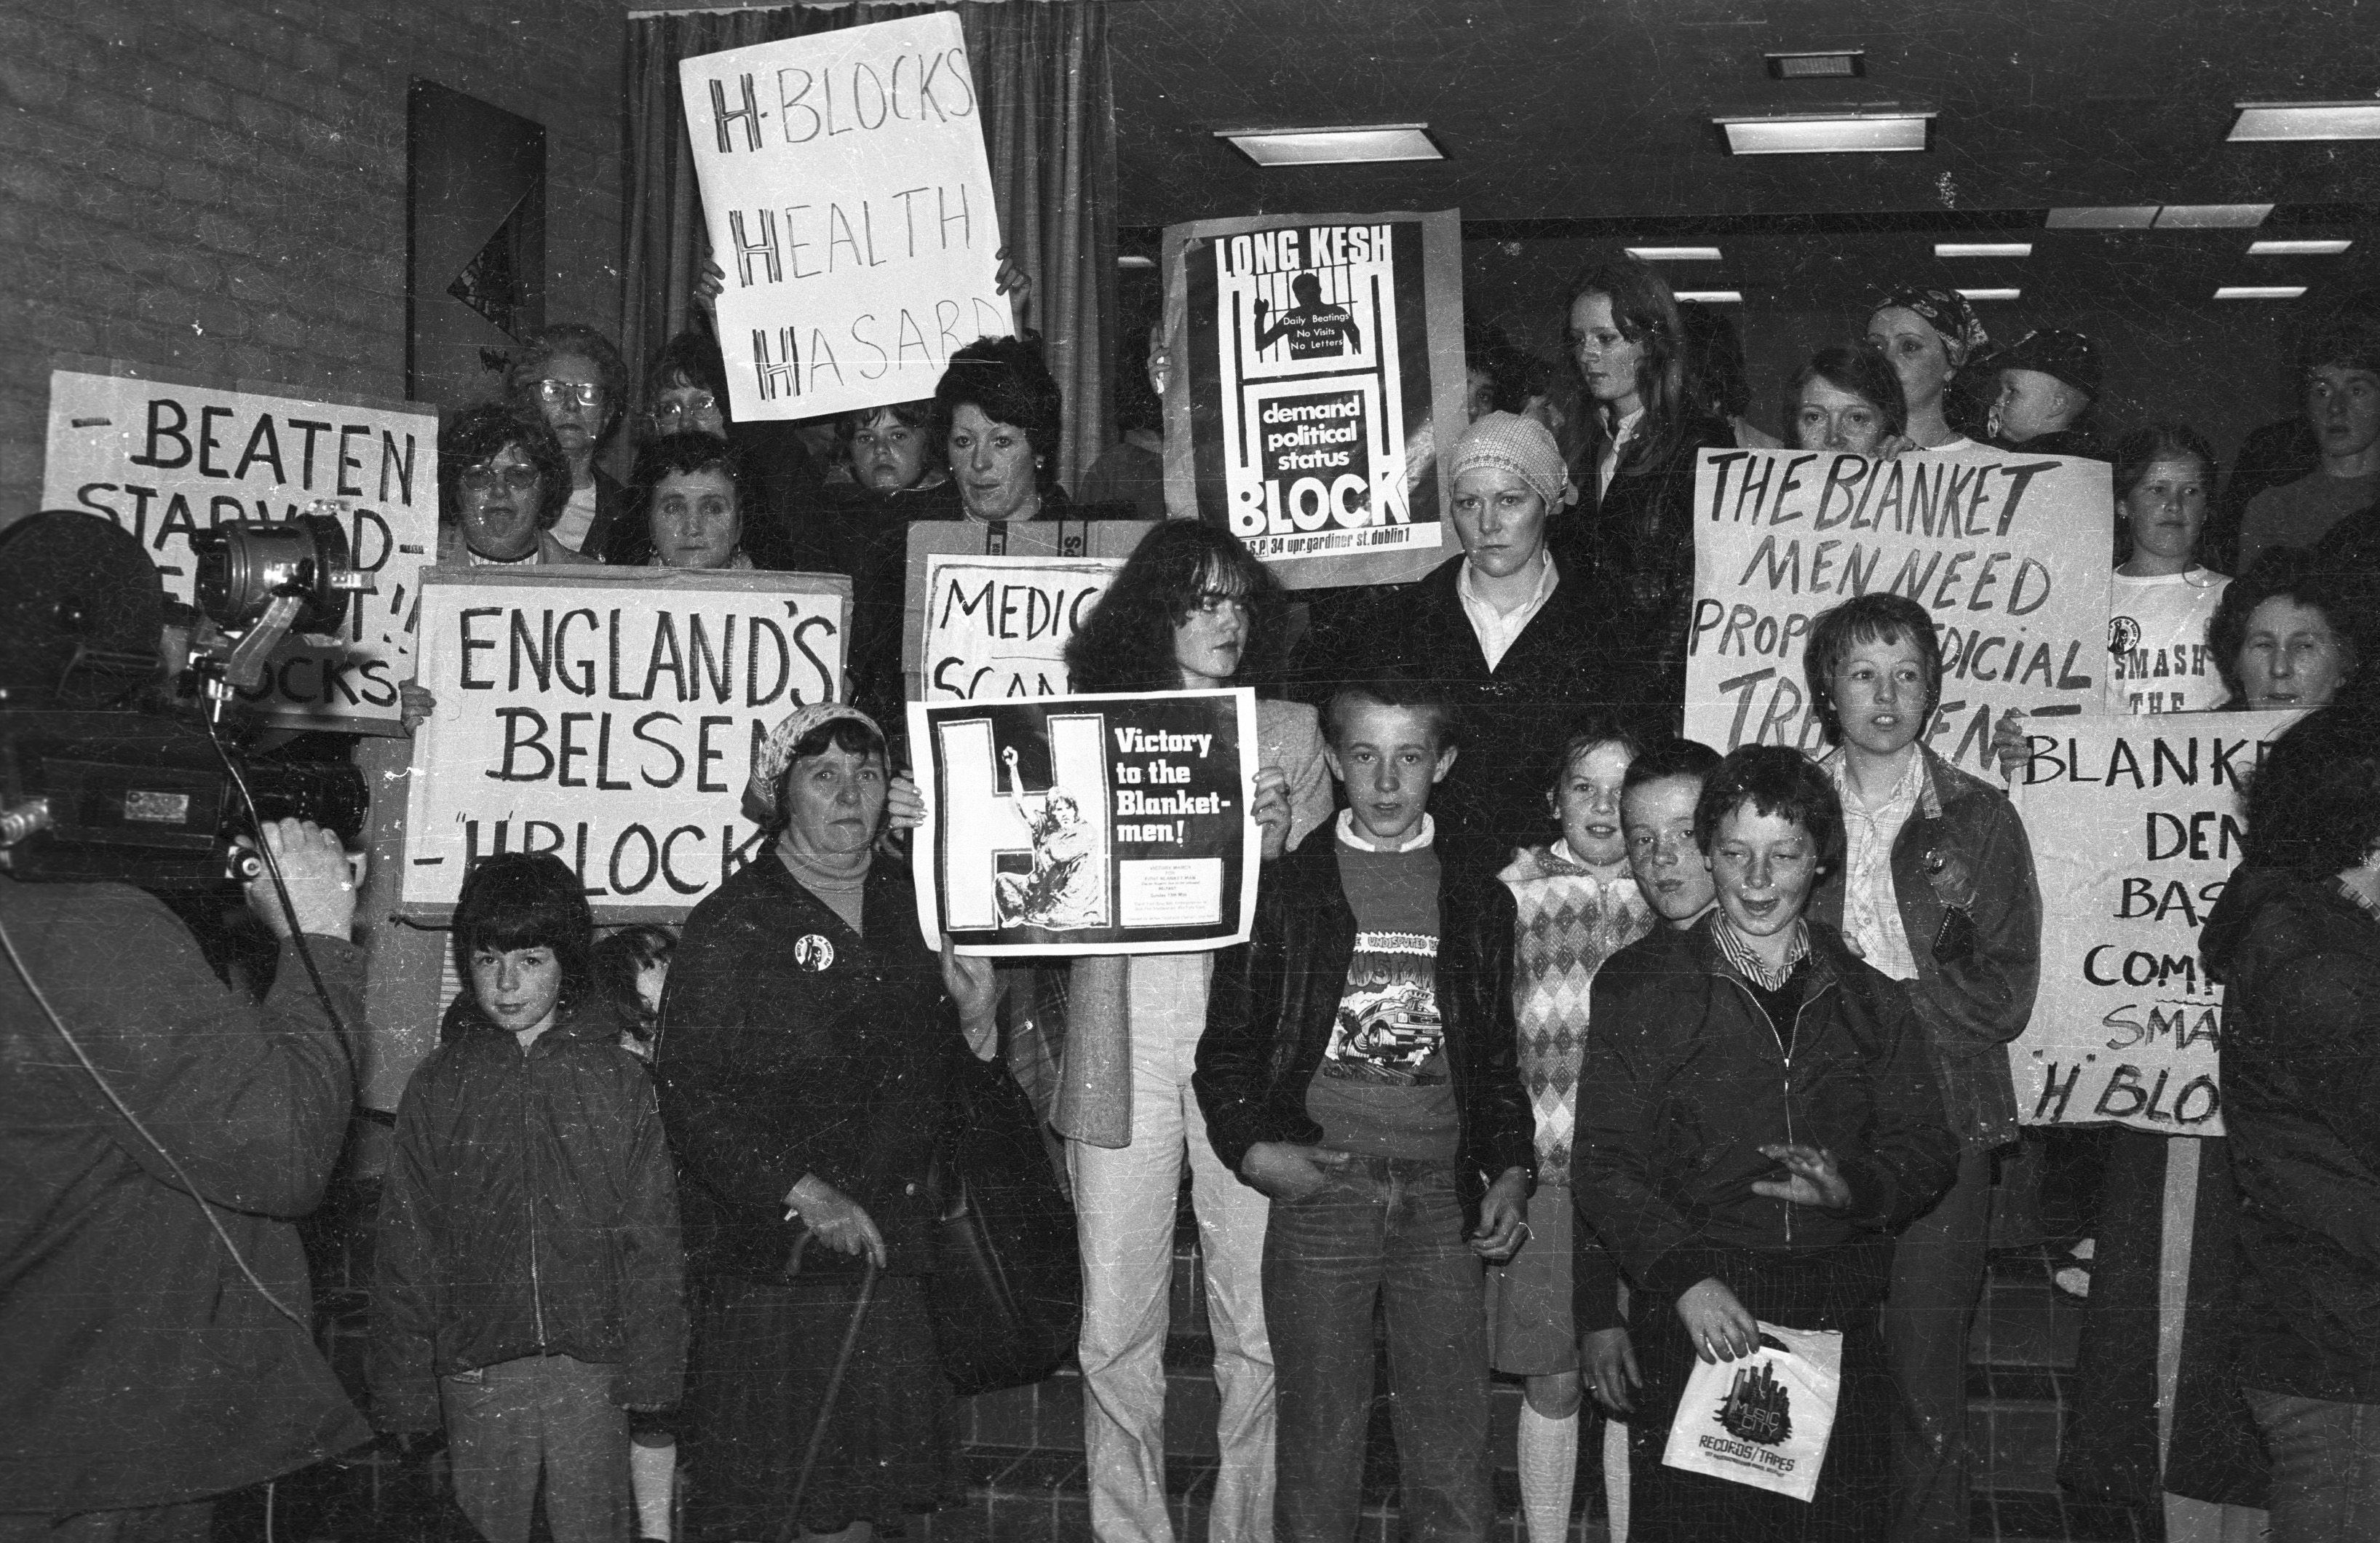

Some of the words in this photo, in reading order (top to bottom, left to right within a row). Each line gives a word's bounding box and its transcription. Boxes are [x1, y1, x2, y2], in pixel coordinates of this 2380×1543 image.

[729, 183, 970, 288] HEALTH
[1215, 230, 1300, 277] LONG
[1310, 225, 1392, 268] KESH
[1283, 315, 1306, 326] Daily
[1312, 312, 1349, 323] Beatings
[1290, 341, 1306, 350] No
[1311, 339, 1344, 349] Letters
[1296, 329, 1311, 338] No
[1313, 328, 1336, 336] Visits
[1263, 395, 1360, 424] demand
[1268, 420, 1357, 451] political
[131, 400, 415, 507] BEATEN
[1278, 450, 1350, 471] status
[1228, 472, 1411, 537] BLOCK
[1707, 451, 1817, 525] THE
[1814, 453, 2063, 539] BLANKET
[1271, 538, 1284, 554] 34
[1357, 530, 1371, 547] st.
[1738, 535, 1881, 597] MEN
[1889, 548, 2051, 616] NEED
[460, 600, 837, 709] ENGLAND'S
[2114, 643, 2208, 680] SMASH
[2130, 691, 2184, 715] THE
[1114, 727, 1212, 758] Victory
[1116, 762, 1141, 784] to
[1149, 759, 1191, 784] the
[1116, 790, 1231, 815] Blanket-
[1116, 820, 1185, 844] men!
[1368, 935, 1428, 949] UNDISPUTED
[1742, 1416, 1779, 1437] CITY
